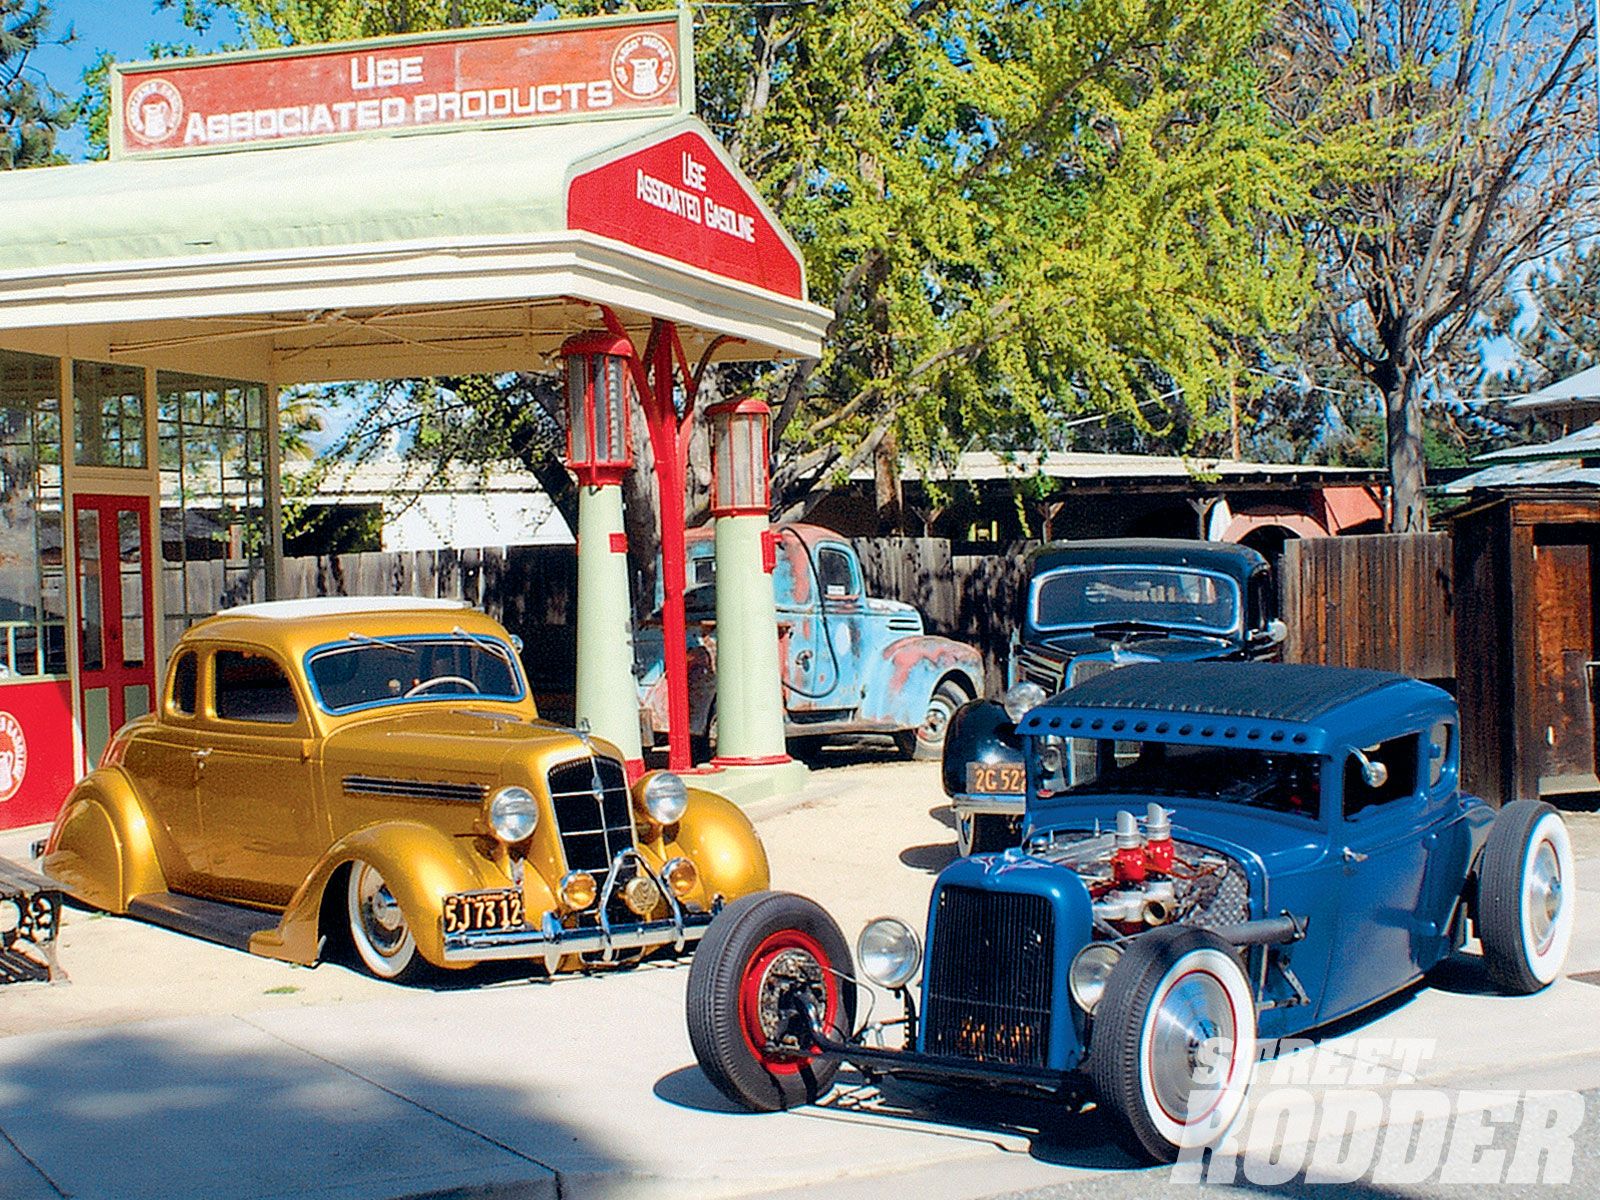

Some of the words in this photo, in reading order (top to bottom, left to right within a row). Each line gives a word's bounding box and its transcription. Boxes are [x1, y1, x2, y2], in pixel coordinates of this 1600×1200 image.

[351, 55, 424, 91] USE
[184, 96, 406, 145] ASSOCIATED
[413, 79, 614, 124] PRODUCTS
[681, 150, 707, 192] USE
[636, 168, 702, 224] ASSOCIATED
[704, 196, 756, 243] GASOLINE
